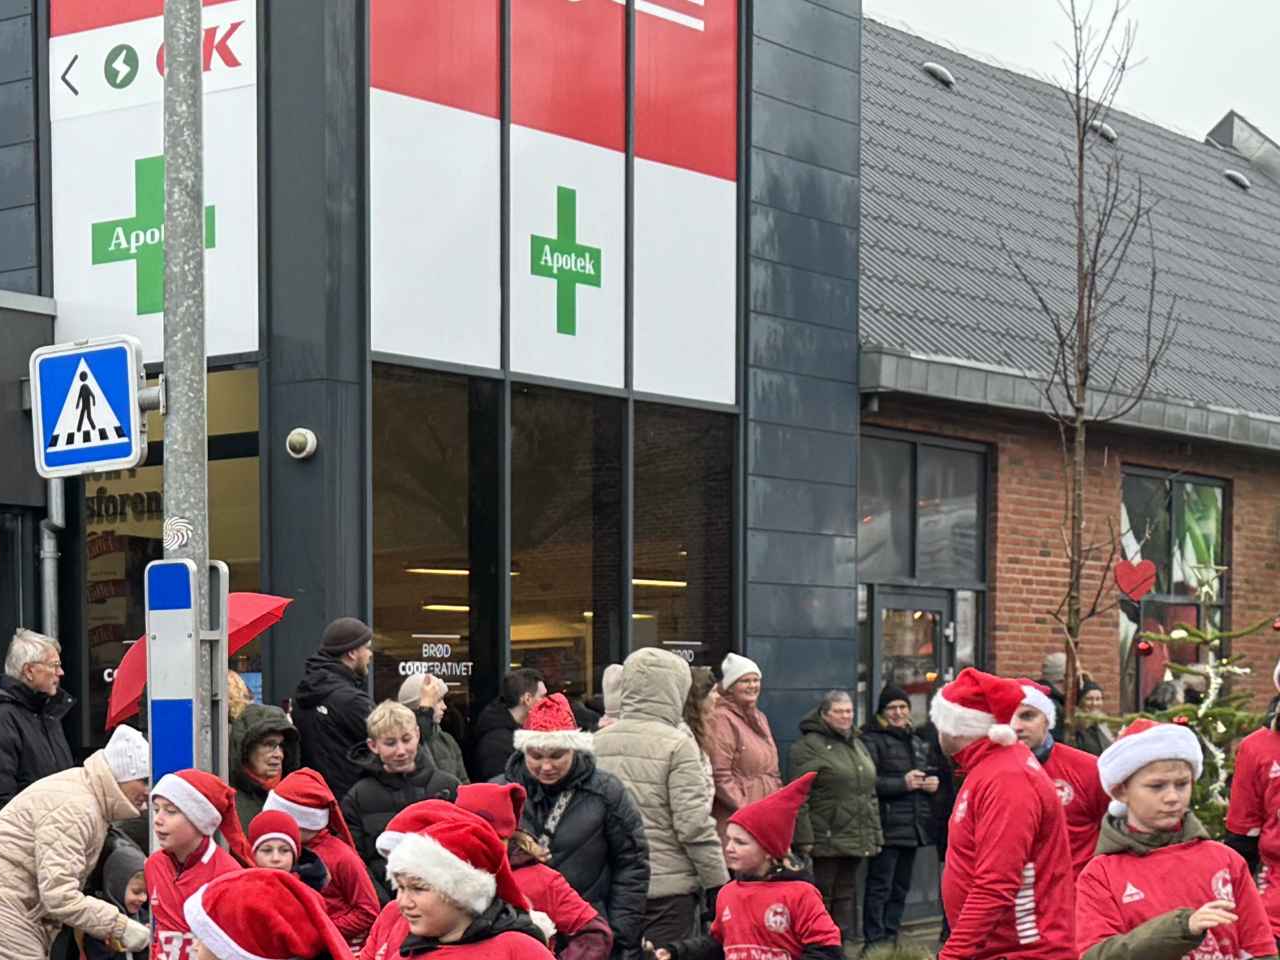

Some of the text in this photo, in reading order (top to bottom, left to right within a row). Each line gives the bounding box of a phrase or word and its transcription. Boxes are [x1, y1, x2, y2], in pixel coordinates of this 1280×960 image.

[108, 224, 165, 253] Apo
[540, 244, 595, 275] Apotek
[422, 643, 451, 657] BRØD
